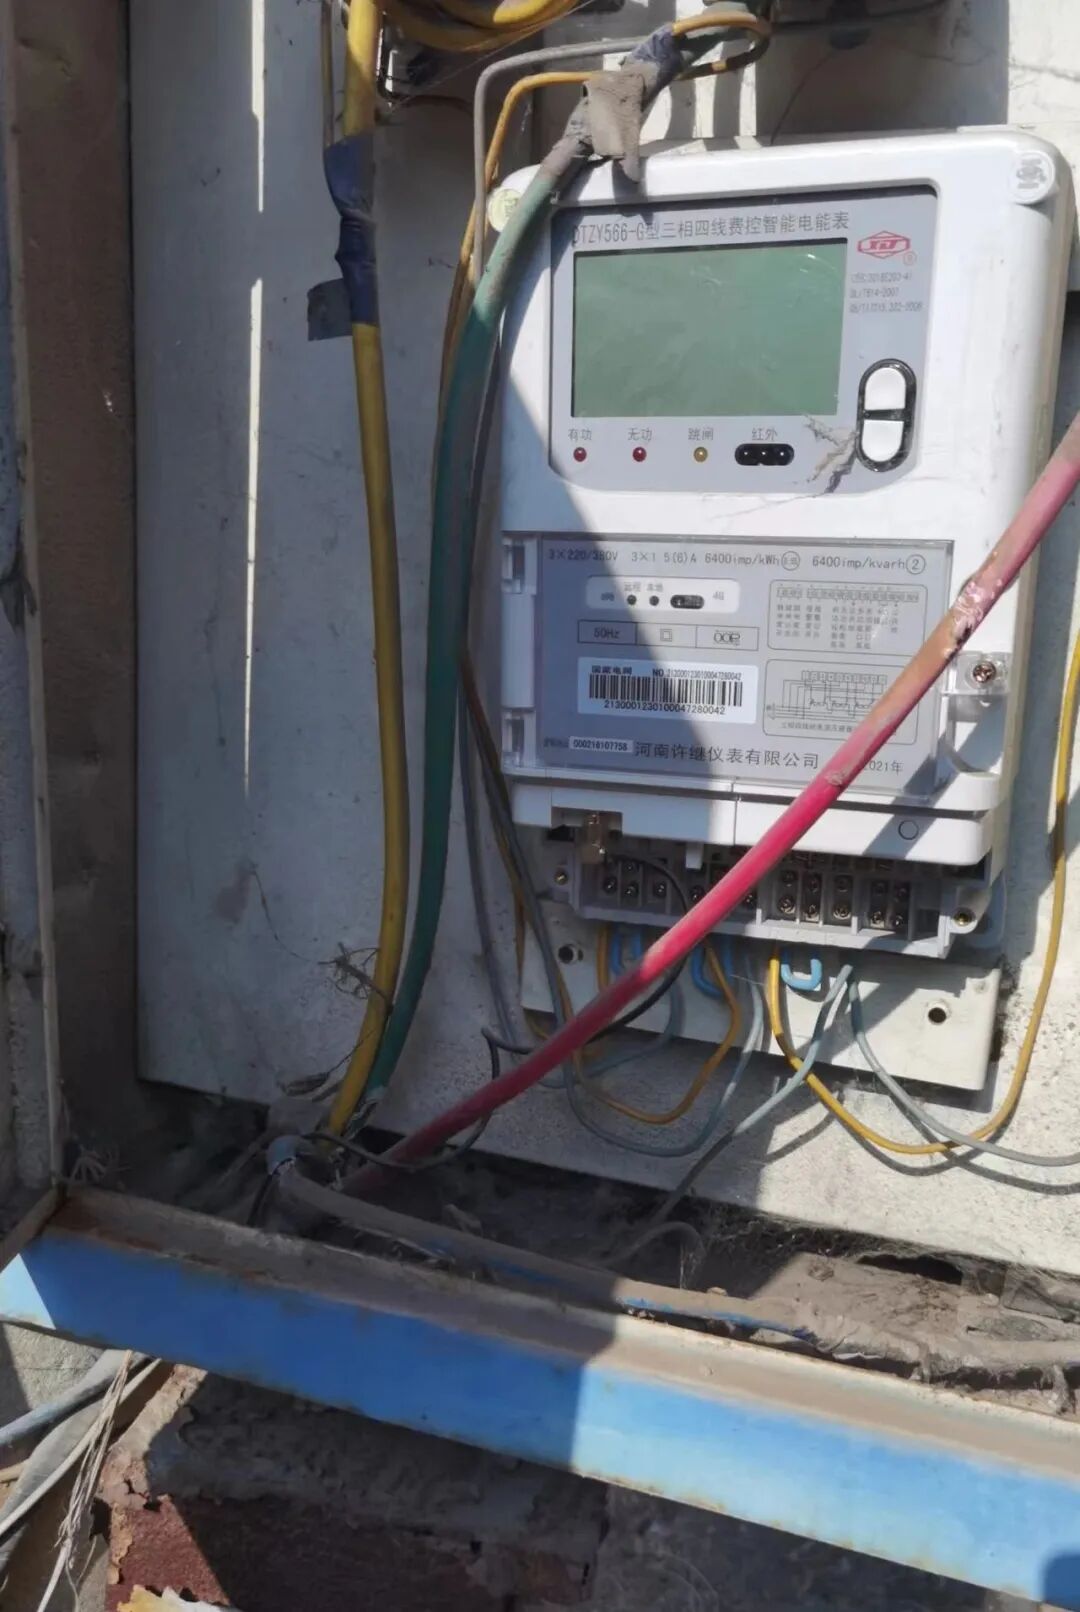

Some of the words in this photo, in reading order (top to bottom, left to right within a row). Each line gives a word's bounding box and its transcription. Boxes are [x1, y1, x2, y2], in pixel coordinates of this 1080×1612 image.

[568, 428, 592, 441] 有功
[627, 428, 653, 441] 无功
[688, 427, 714, 441] 跳闸
[751, 427, 778, 441] 红外
[593, 627, 621, 640] 50Hz
[634, 741, 819, 769] 河南许继仪表有限公司
